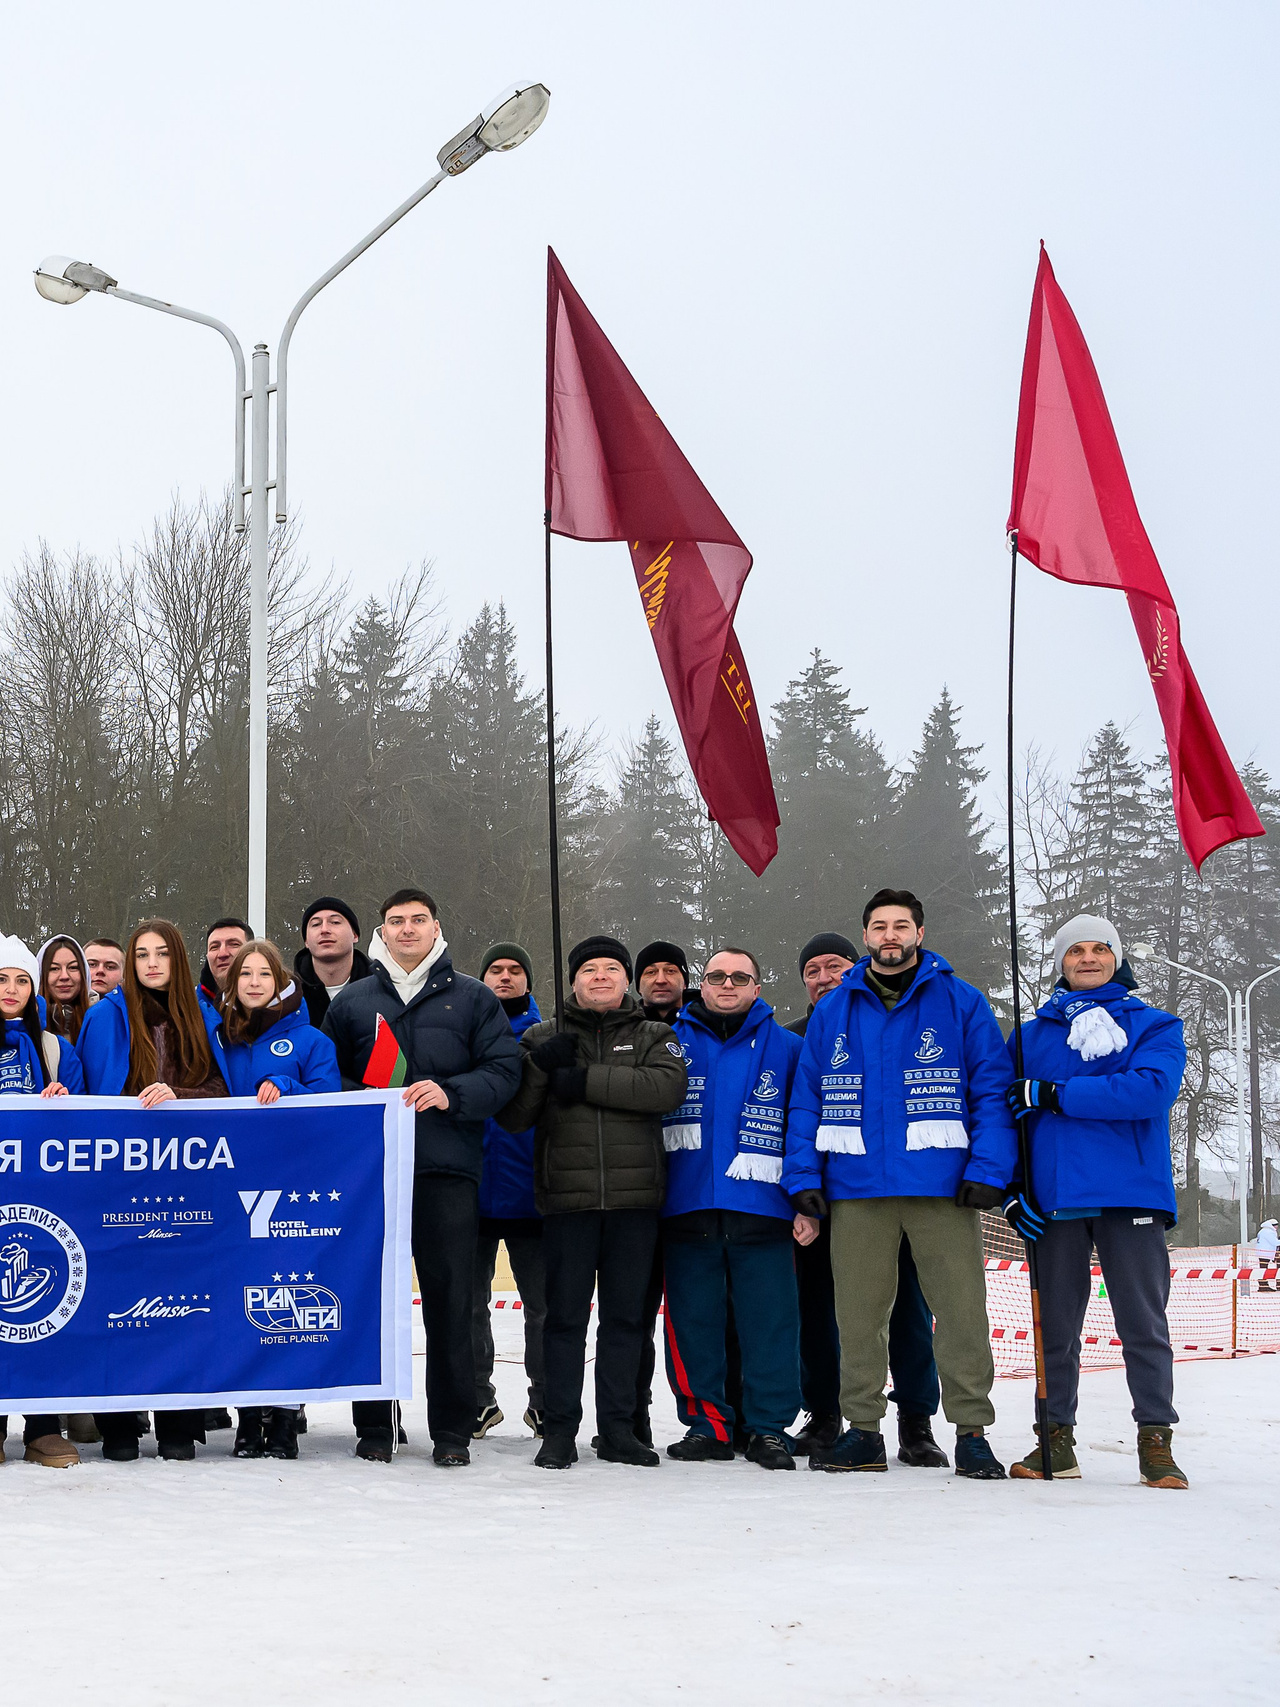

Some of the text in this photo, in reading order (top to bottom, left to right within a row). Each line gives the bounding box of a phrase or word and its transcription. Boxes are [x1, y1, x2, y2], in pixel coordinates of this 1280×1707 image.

[910, 1086, 956, 1095] АКАДЕМИЯ
[39, 1137, 235, 1173] СЕРВИСА
[103, 1210, 214, 1223] PRESIDENT HOTEL
[270, 1220, 308, 1229] HOTEL
[270, 1227, 342, 1238] YUBILEINY
[107, 1320, 150, 1328] HOTEL
[260, 1334, 329, 1345] HOTEL PLANETA
